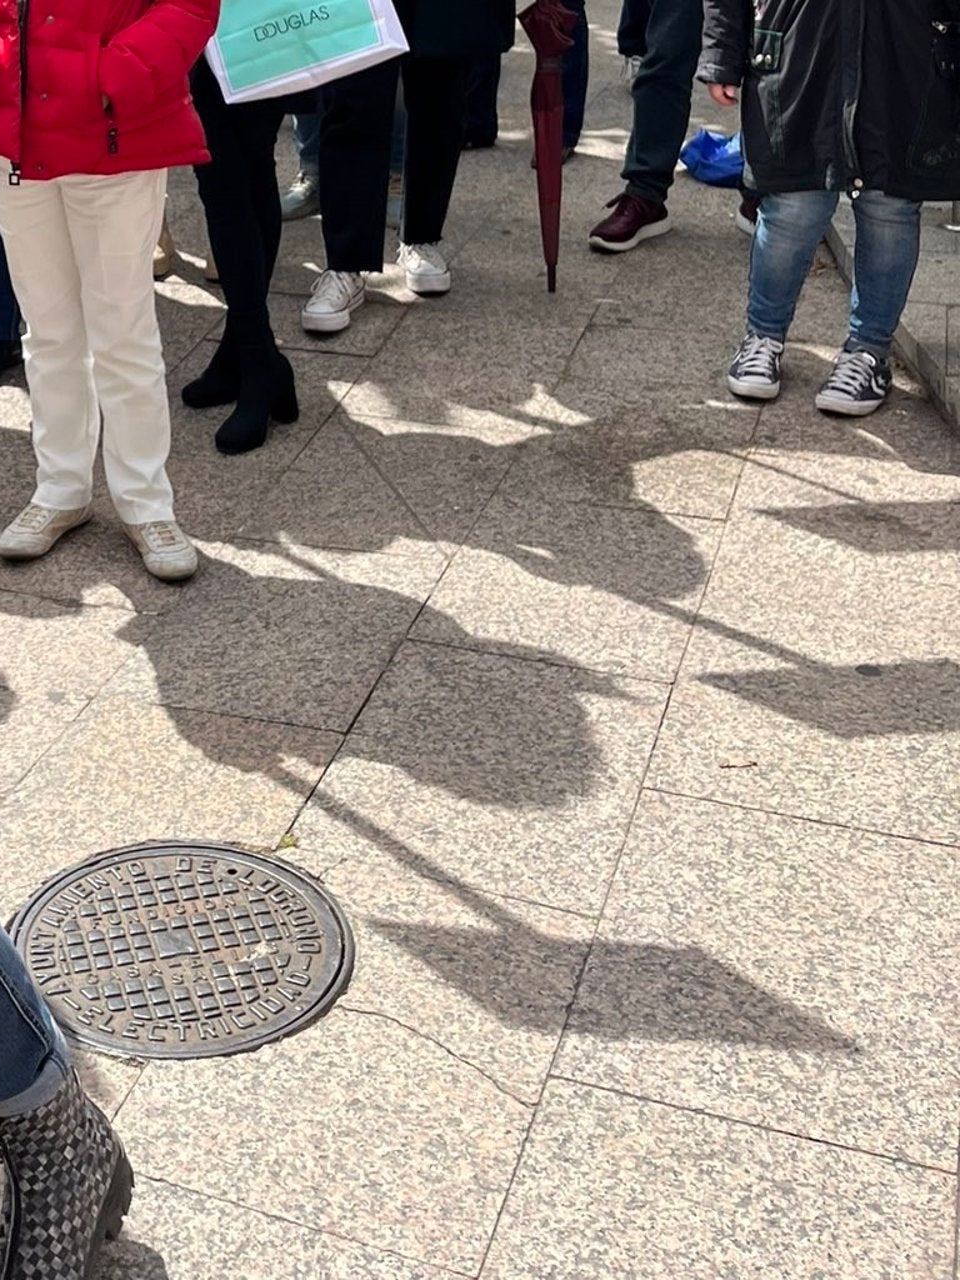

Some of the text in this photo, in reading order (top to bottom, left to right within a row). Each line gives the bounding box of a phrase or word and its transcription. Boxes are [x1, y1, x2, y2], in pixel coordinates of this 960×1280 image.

[253, 5, 330, 42] DOUGLAS
[31, 861, 145, 996] AYUNTAMIENTO
[175, 857, 217, 874] DE
[77, 972, 311, 1042] ELECTRICIDAD
